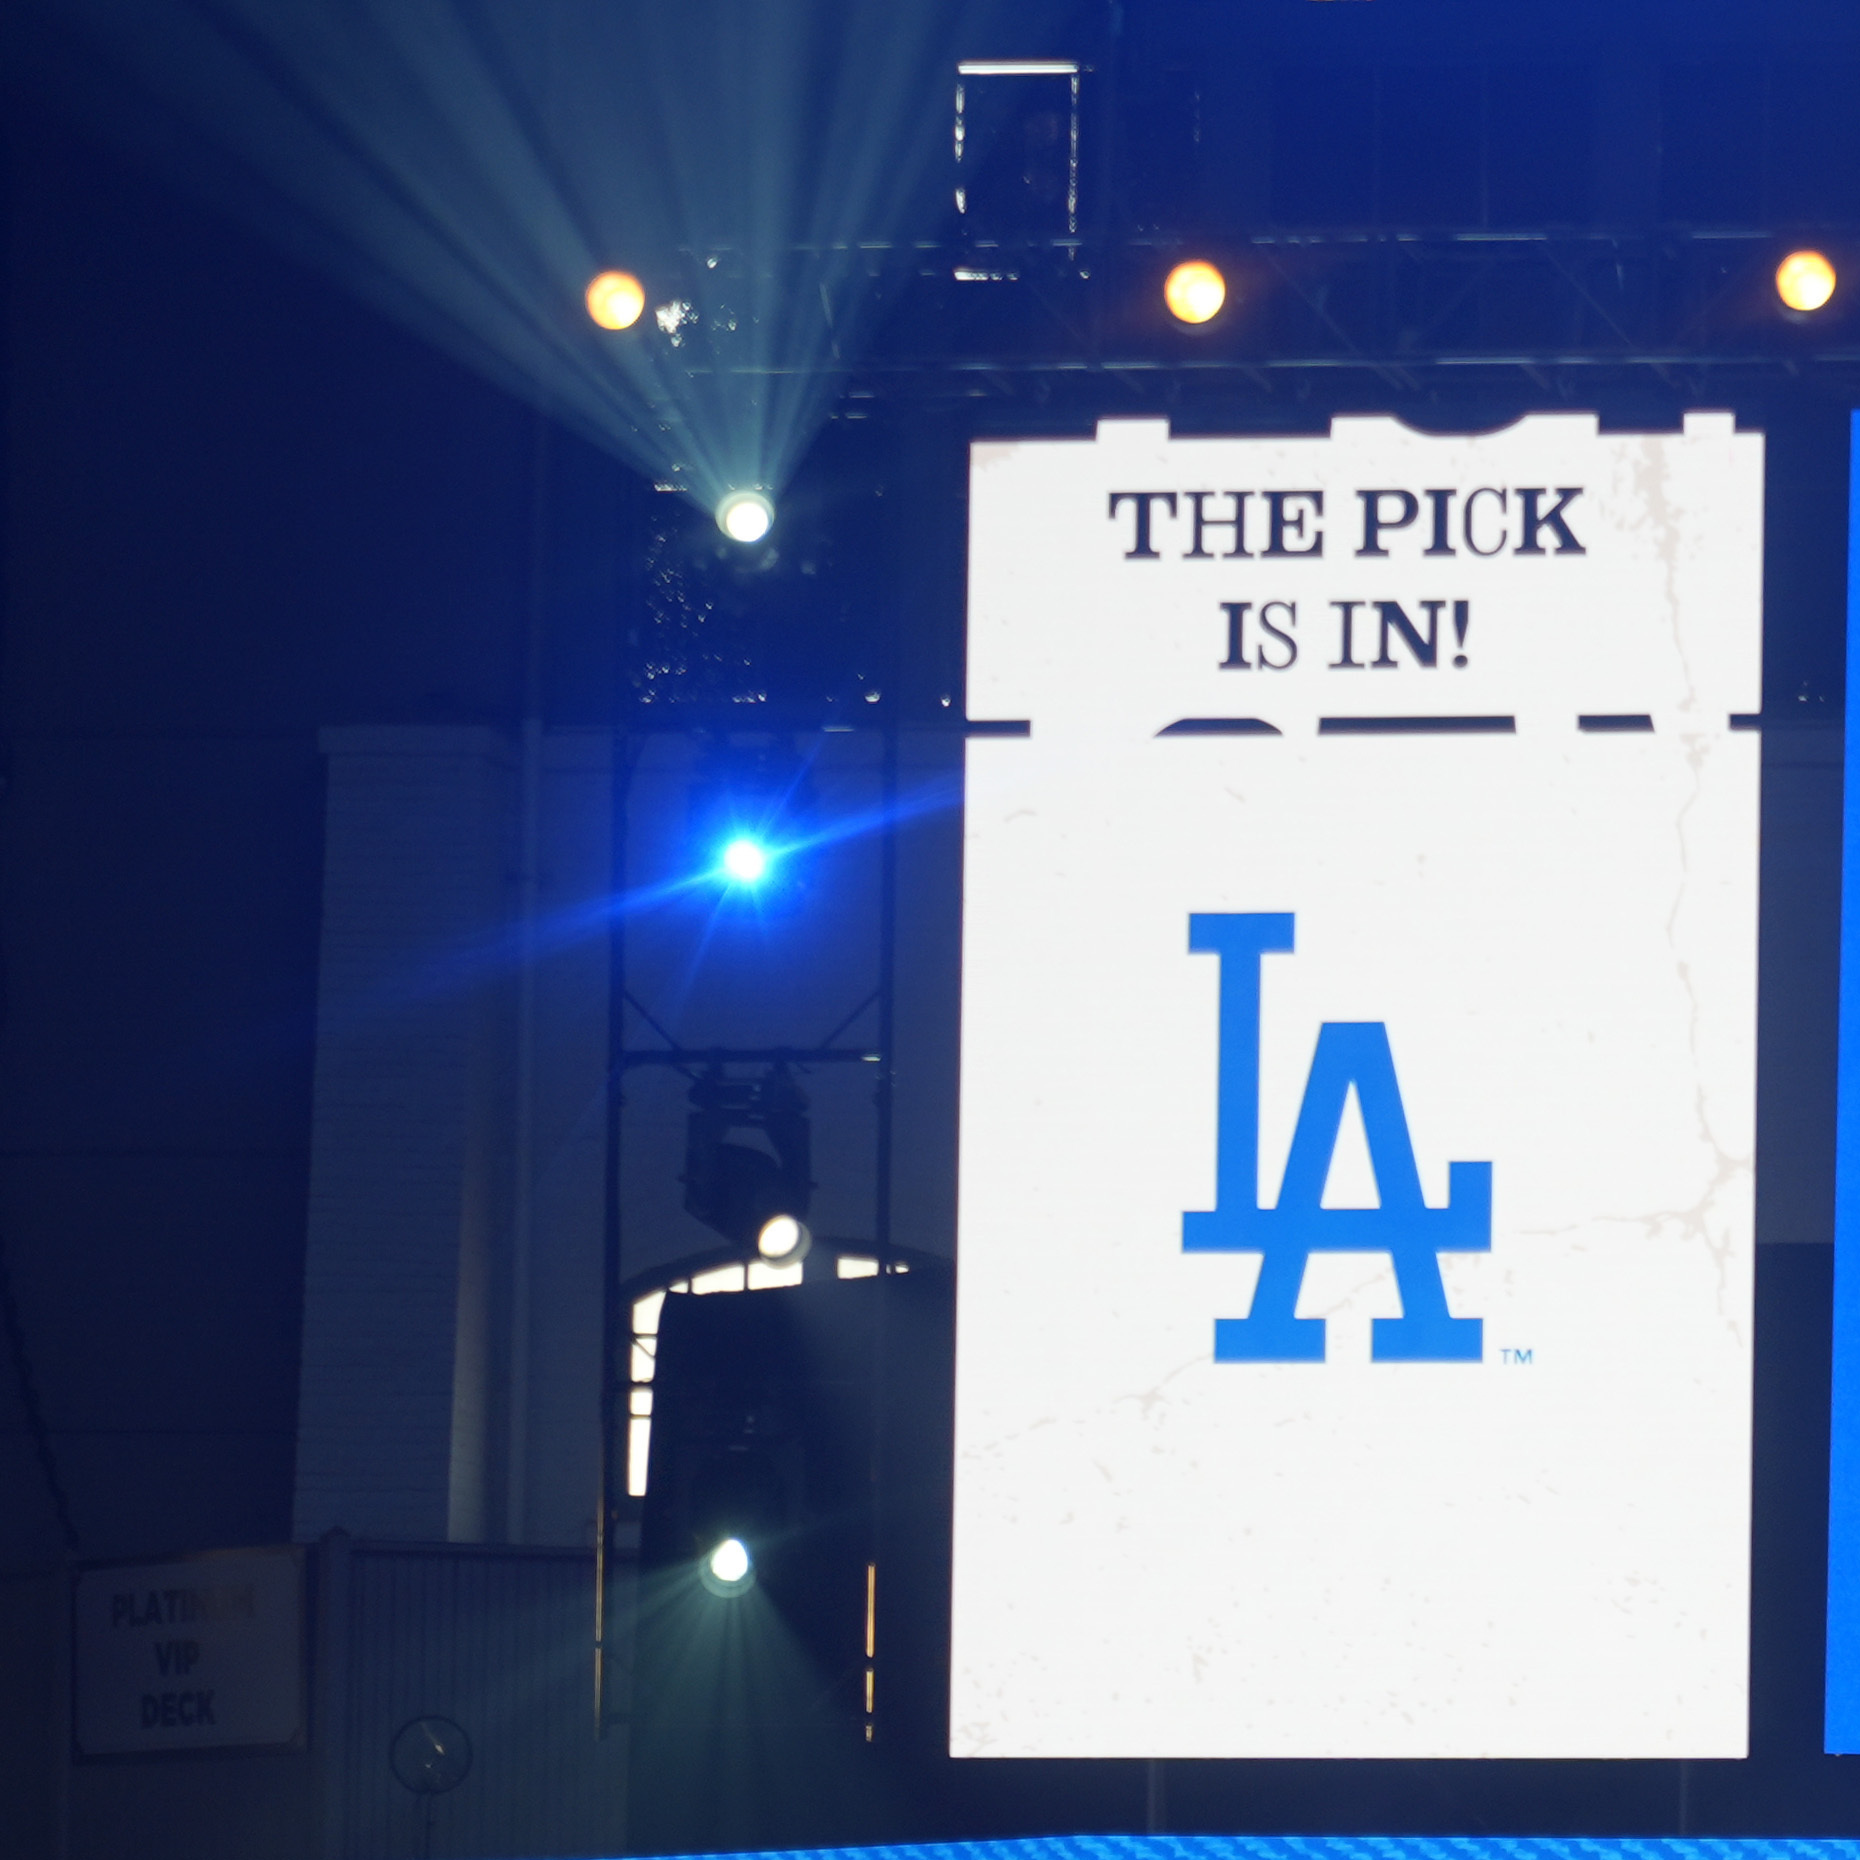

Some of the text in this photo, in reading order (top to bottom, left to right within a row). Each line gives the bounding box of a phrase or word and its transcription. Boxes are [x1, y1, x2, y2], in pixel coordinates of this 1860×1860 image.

[1108, 486, 1587, 560] THE PICK
[1218, 599, 1470, 670] IS IN!
[1182, 912, 1492, 1362] LA
[111, 1584, 255, 1627] PLATIN
[152, 1639, 200, 1677] VIP
[140, 1689, 216, 1729] DECK
